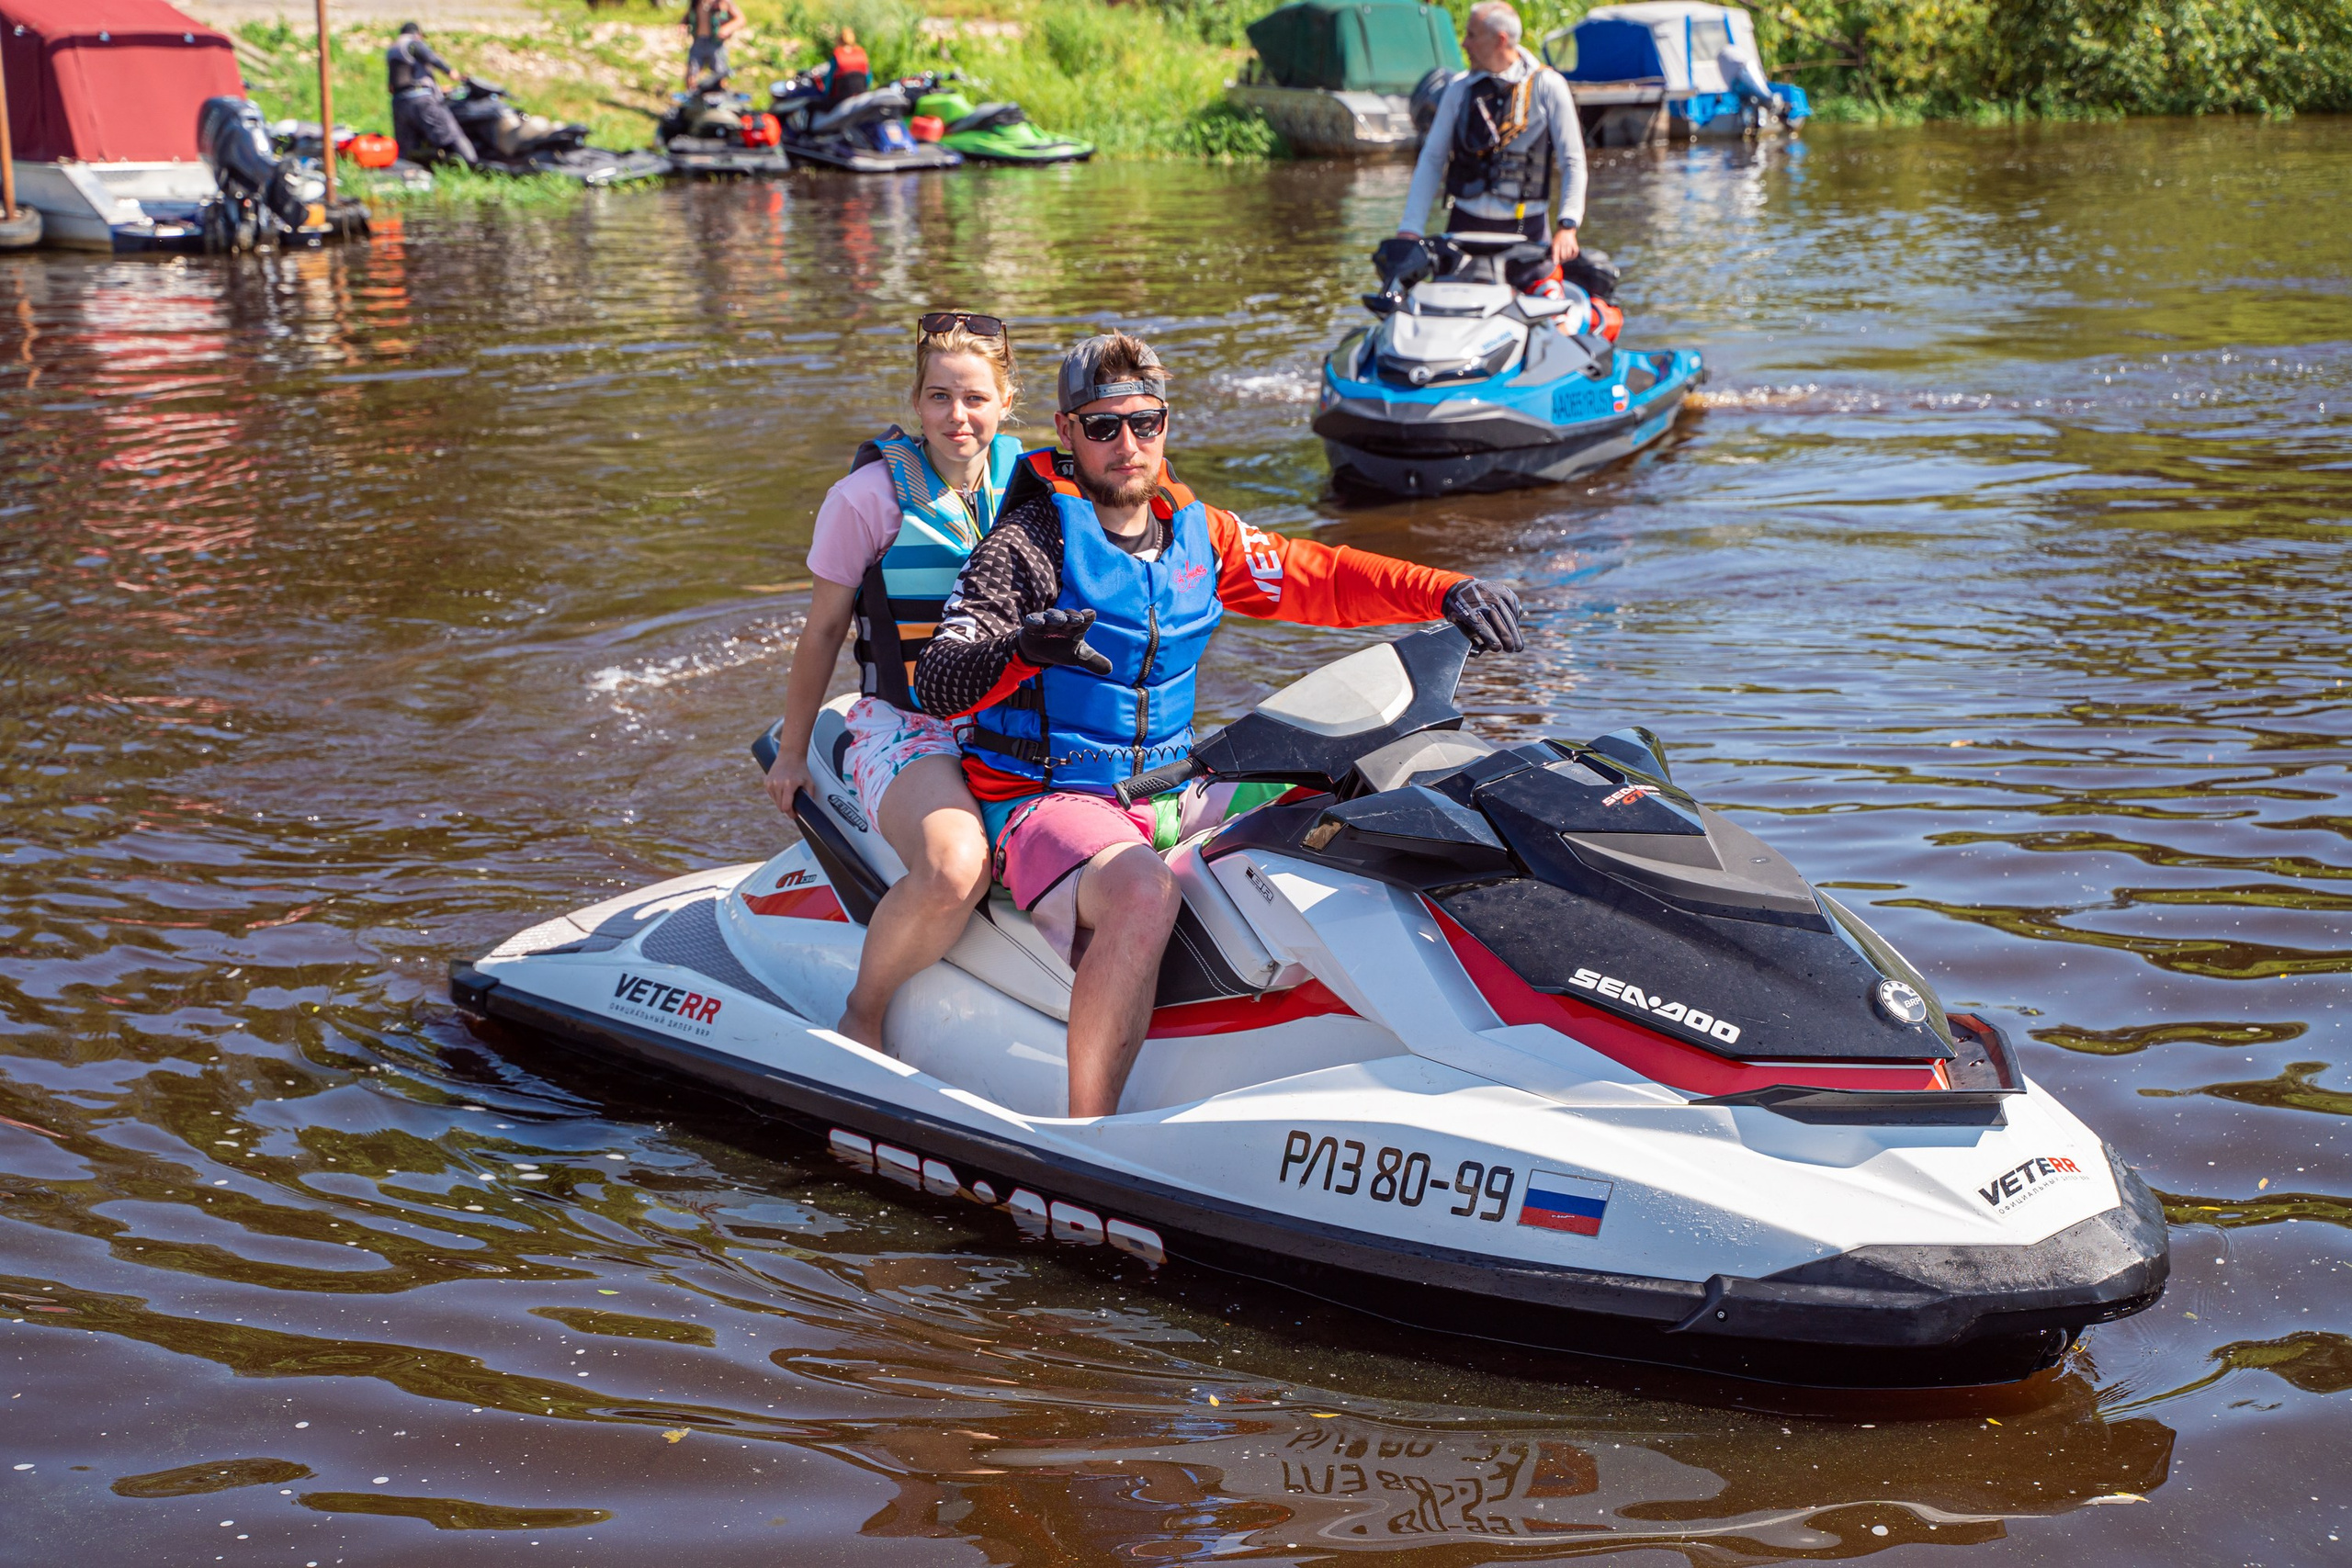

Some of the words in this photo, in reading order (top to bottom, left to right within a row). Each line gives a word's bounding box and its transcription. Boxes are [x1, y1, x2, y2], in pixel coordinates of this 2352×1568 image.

[614, 973, 722, 1025] VETERR
[1904, 997, 1920, 1009] BRP
[1369, 1146, 1516, 1223] 80-99
[1977, 1156, 2082, 1207] VETERR
